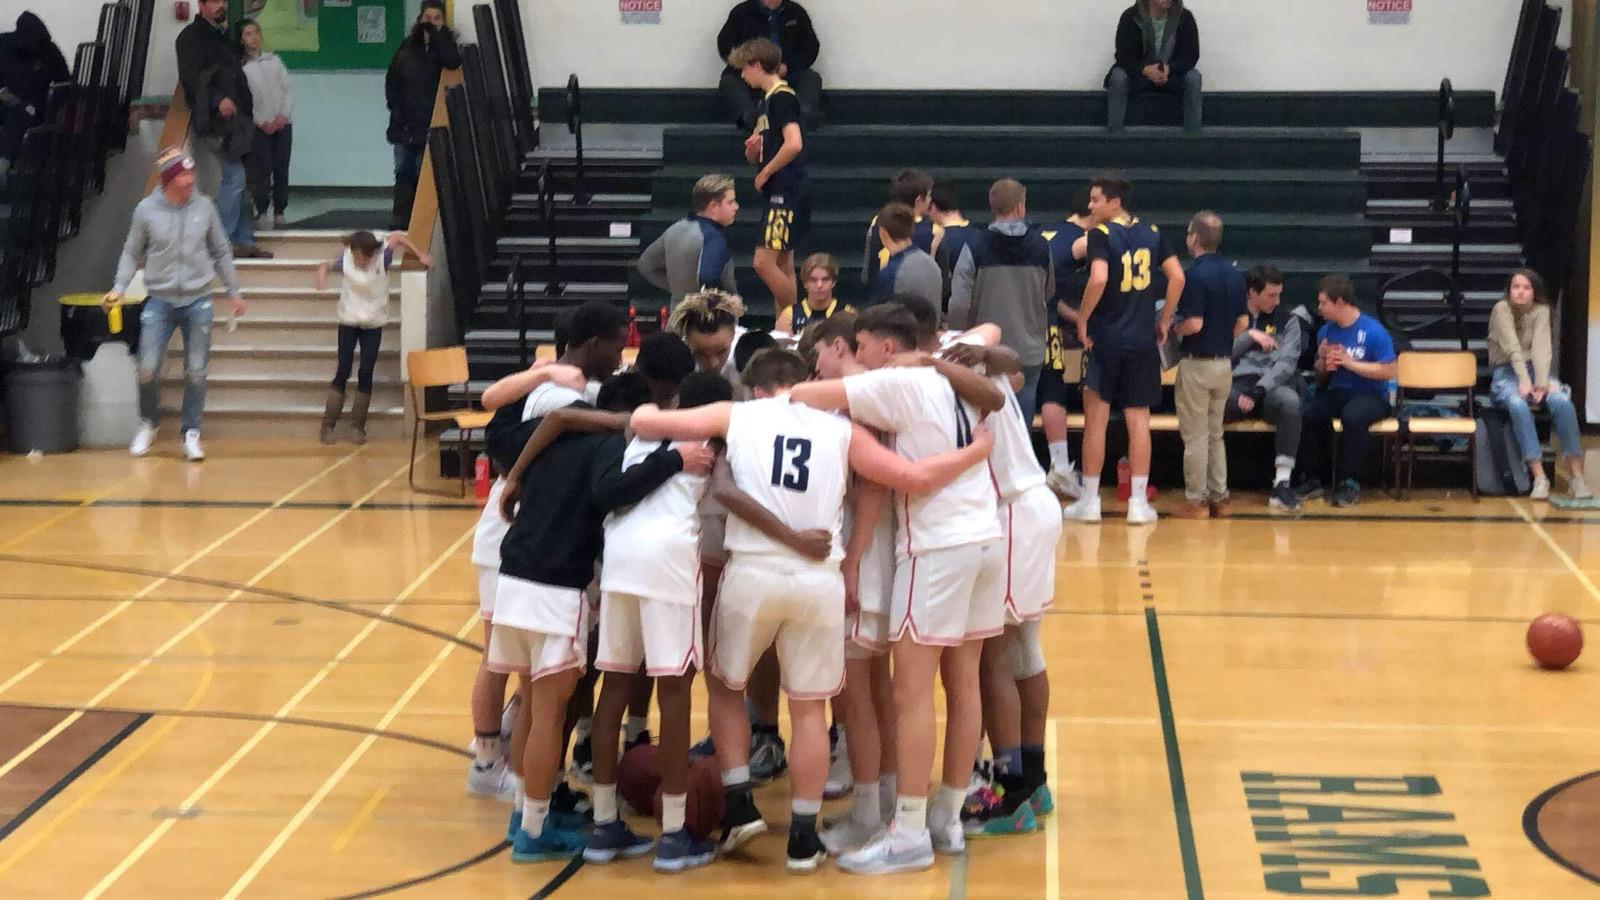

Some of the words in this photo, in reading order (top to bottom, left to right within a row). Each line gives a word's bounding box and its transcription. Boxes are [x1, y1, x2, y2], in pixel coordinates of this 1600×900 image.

[620, 0, 660, 10] NOTICE
[1368, 0, 1411, 10] NOTICE
[1120, 247, 1151, 292] 13
[771, 434, 811, 492] 13
[1240, 771, 1491, 898] RAMS
